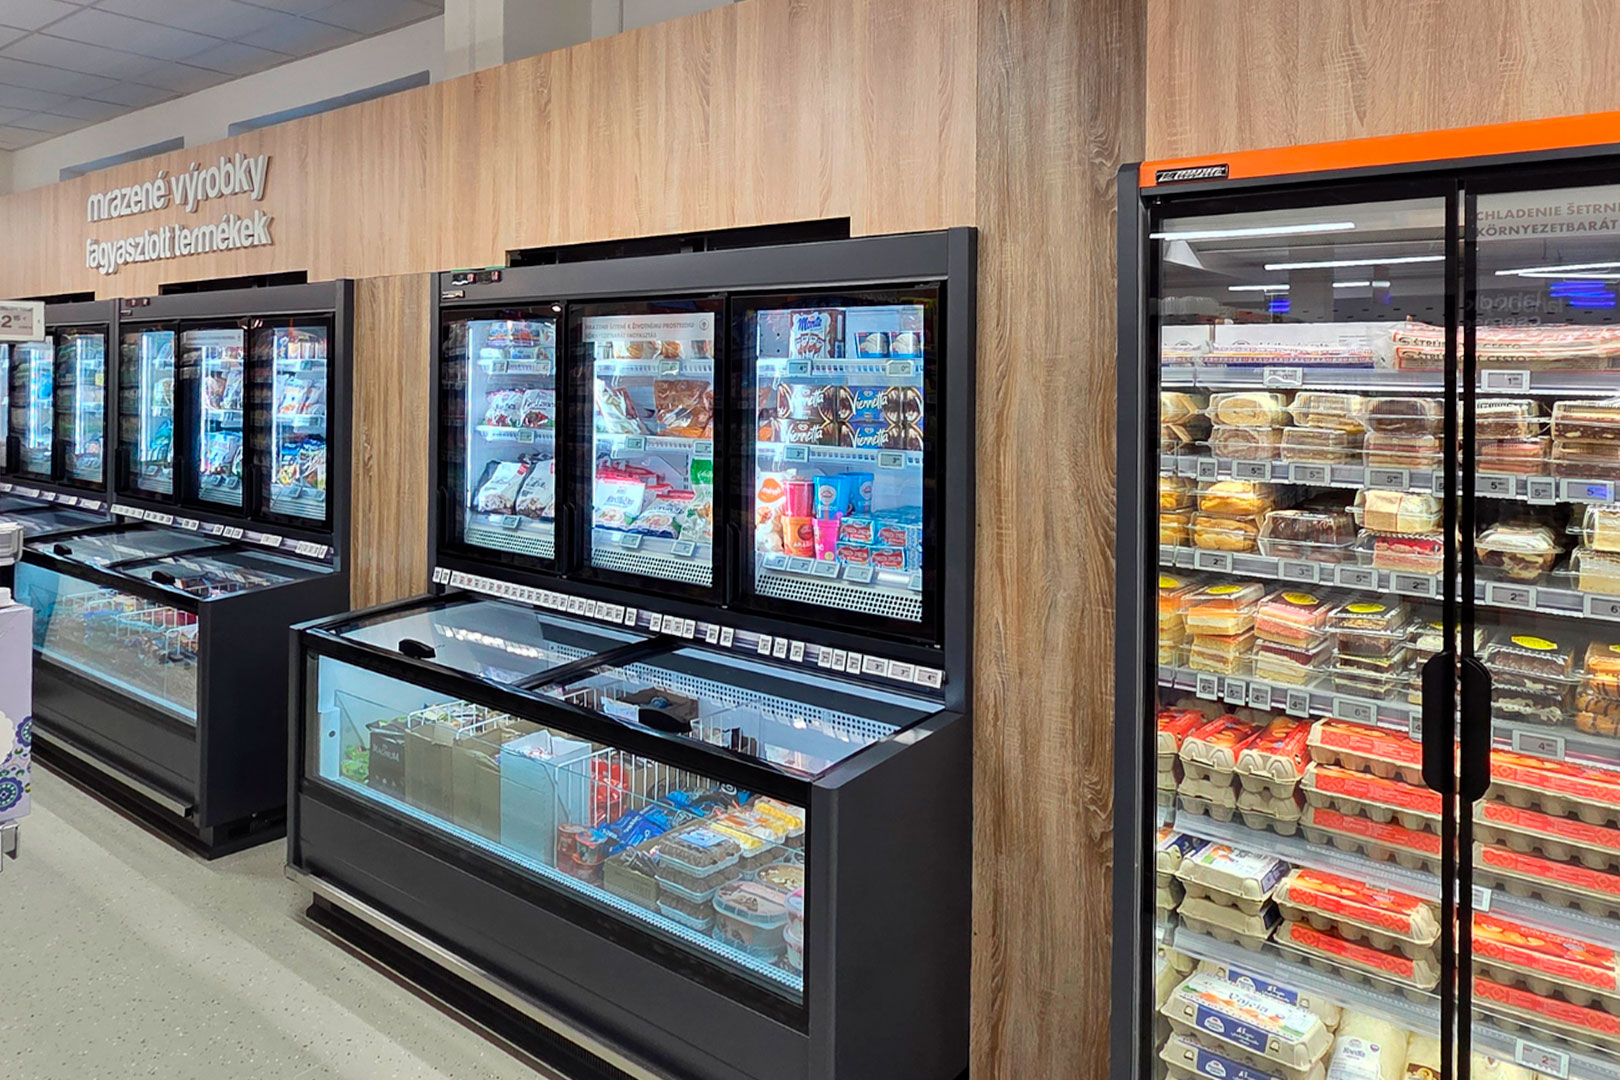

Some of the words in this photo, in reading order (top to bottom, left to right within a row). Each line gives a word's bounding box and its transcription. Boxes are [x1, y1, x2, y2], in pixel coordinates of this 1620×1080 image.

[88, 170, 167, 222] mrazené
[171, 152, 269, 212] výrobky
[1477, 206, 1561, 220] CHLADENIE
[1567, 202, 1620, 216] ŠETRN
[1477, 217, 1618, 237] KÖRNYEZETBARÁT
[86, 225, 174, 275] fagyasztott
[174, 210, 273, 257] termékek
